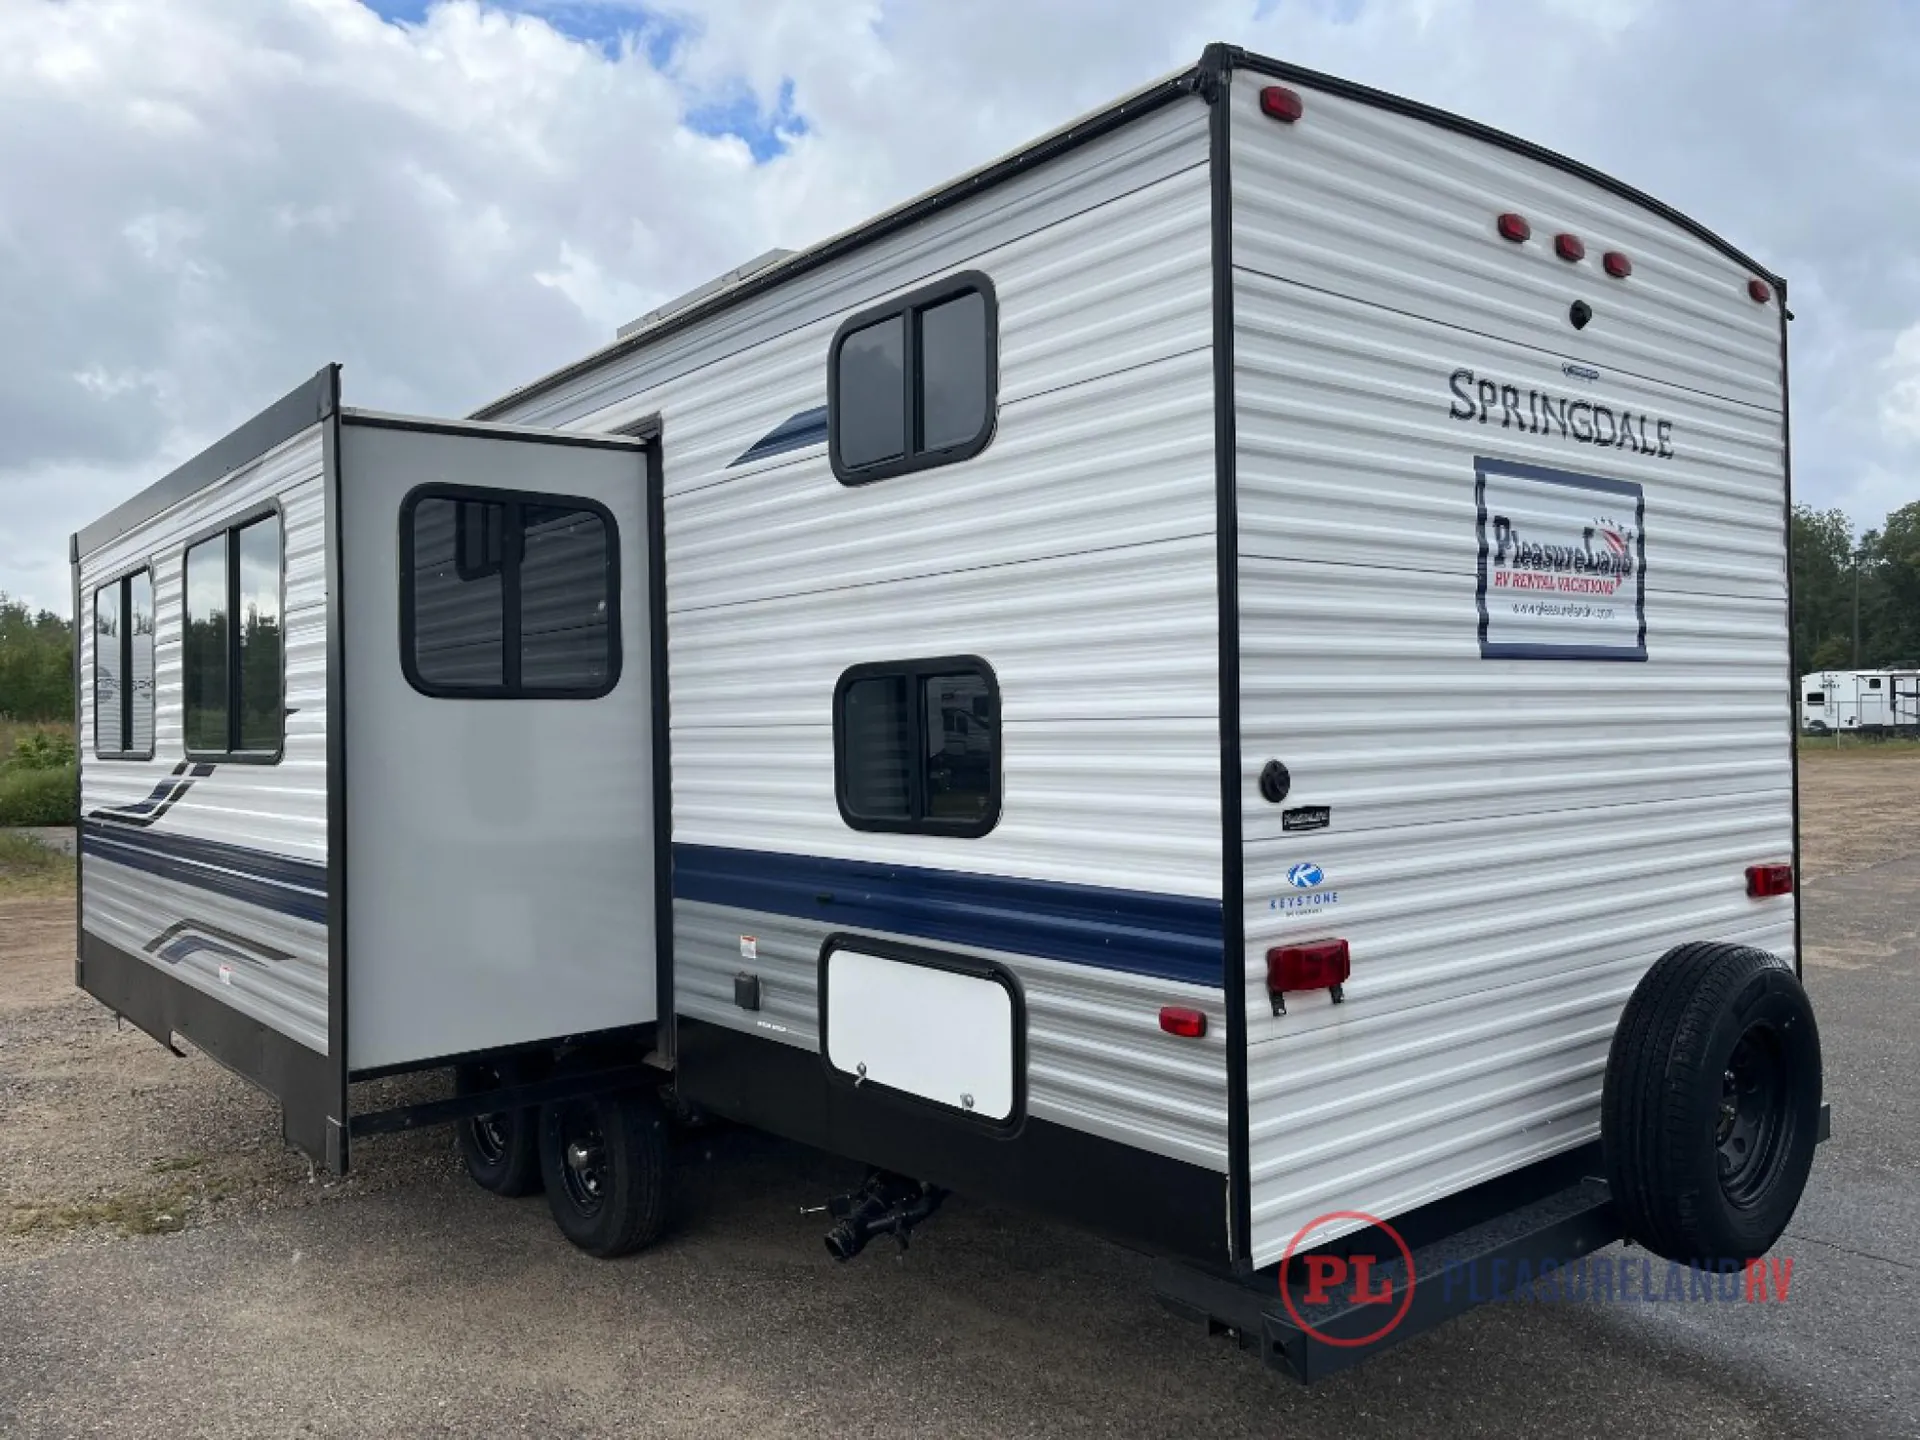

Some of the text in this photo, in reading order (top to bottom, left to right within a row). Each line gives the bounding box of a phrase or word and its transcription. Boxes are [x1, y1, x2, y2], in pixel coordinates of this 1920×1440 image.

[1449, 367, 1675, 459] SPRINGDALE
[1494, 571, 1614, 595] RV RENTAL VACATIONS
[1270, 892, 1338, 910] KEYSTONE
